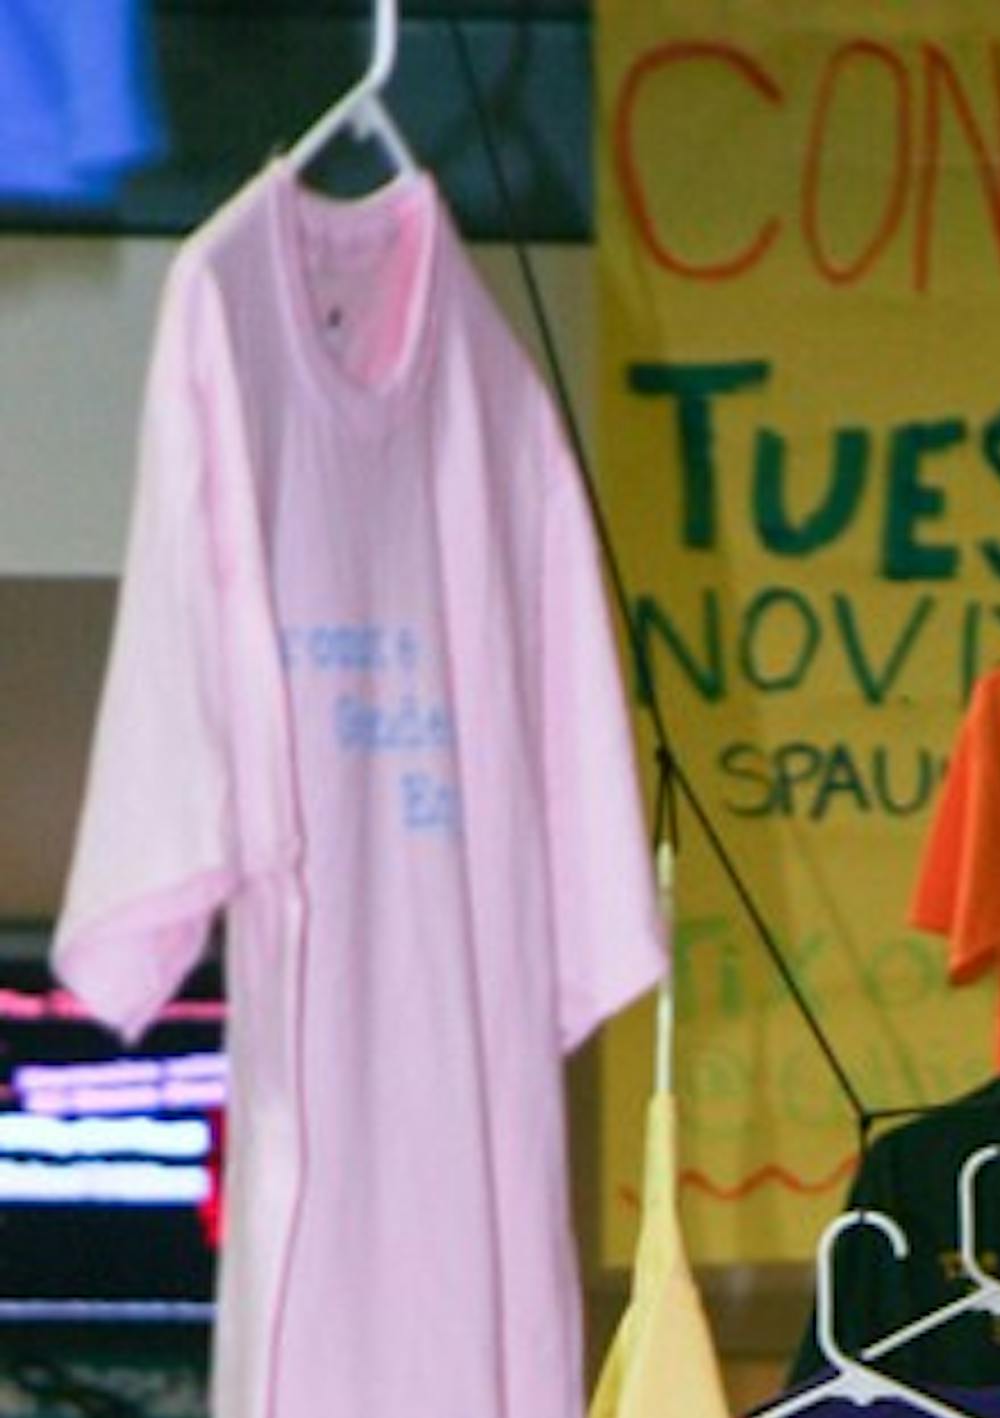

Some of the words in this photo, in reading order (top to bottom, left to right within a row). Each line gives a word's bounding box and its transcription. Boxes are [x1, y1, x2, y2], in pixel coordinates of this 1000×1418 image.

[632, 587, 936, 704] NOV
[716, 740, 948, 822] SPAU
[942, 1252, 998, 1281] Te
